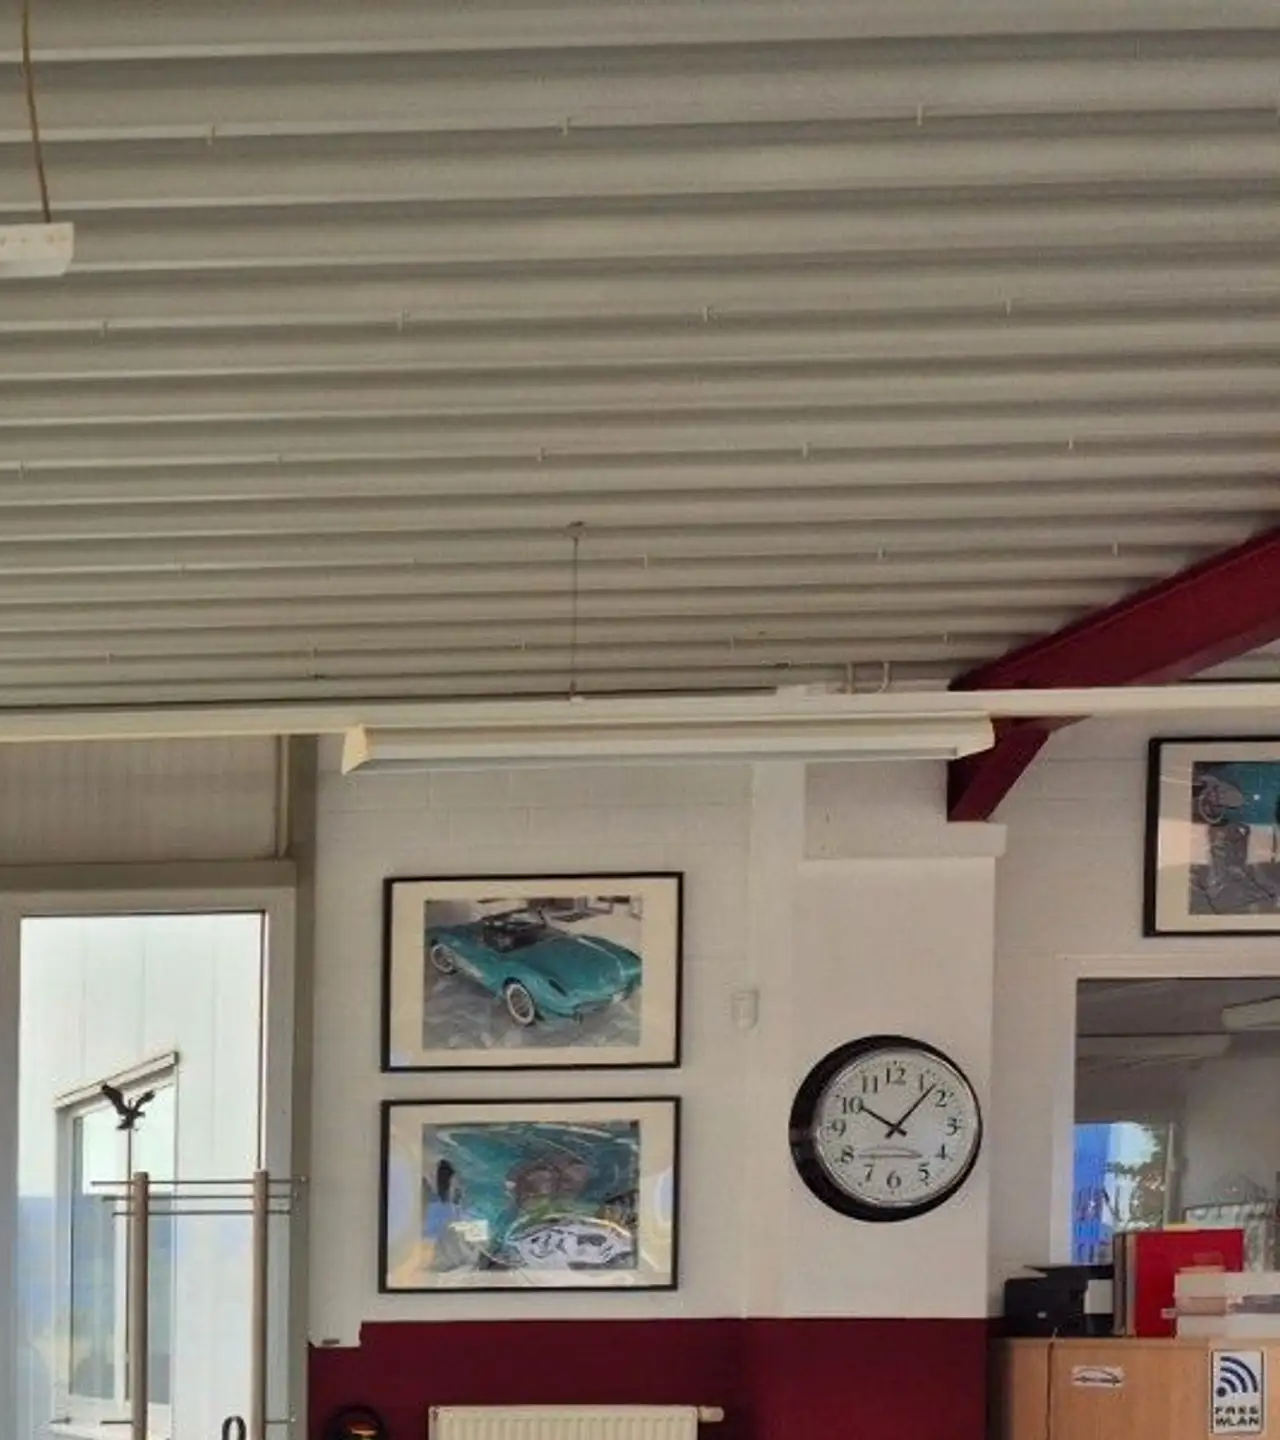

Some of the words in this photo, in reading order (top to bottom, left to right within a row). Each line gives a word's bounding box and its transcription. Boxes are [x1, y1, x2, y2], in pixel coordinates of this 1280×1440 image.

[861, 1075, 878, 1093] 11
[886, 1067, 906, 1085] 12
[842, 1097, 863, 1115] 10
[935, 1090, 948, 1107] 2
[831, 1118, 846, 1136] 9
[945, 1116, 958, 1136] 3
[840, 1145, 854, 1164] 8
[935, 1144, 947, 1160] 4
[864, 1163, 875, 1182] 7
[886, 1170, 901, 1189] 6
[918, 1162, 931, 1182] 5
[1215, 1416, 1259, 1427] WLAN
